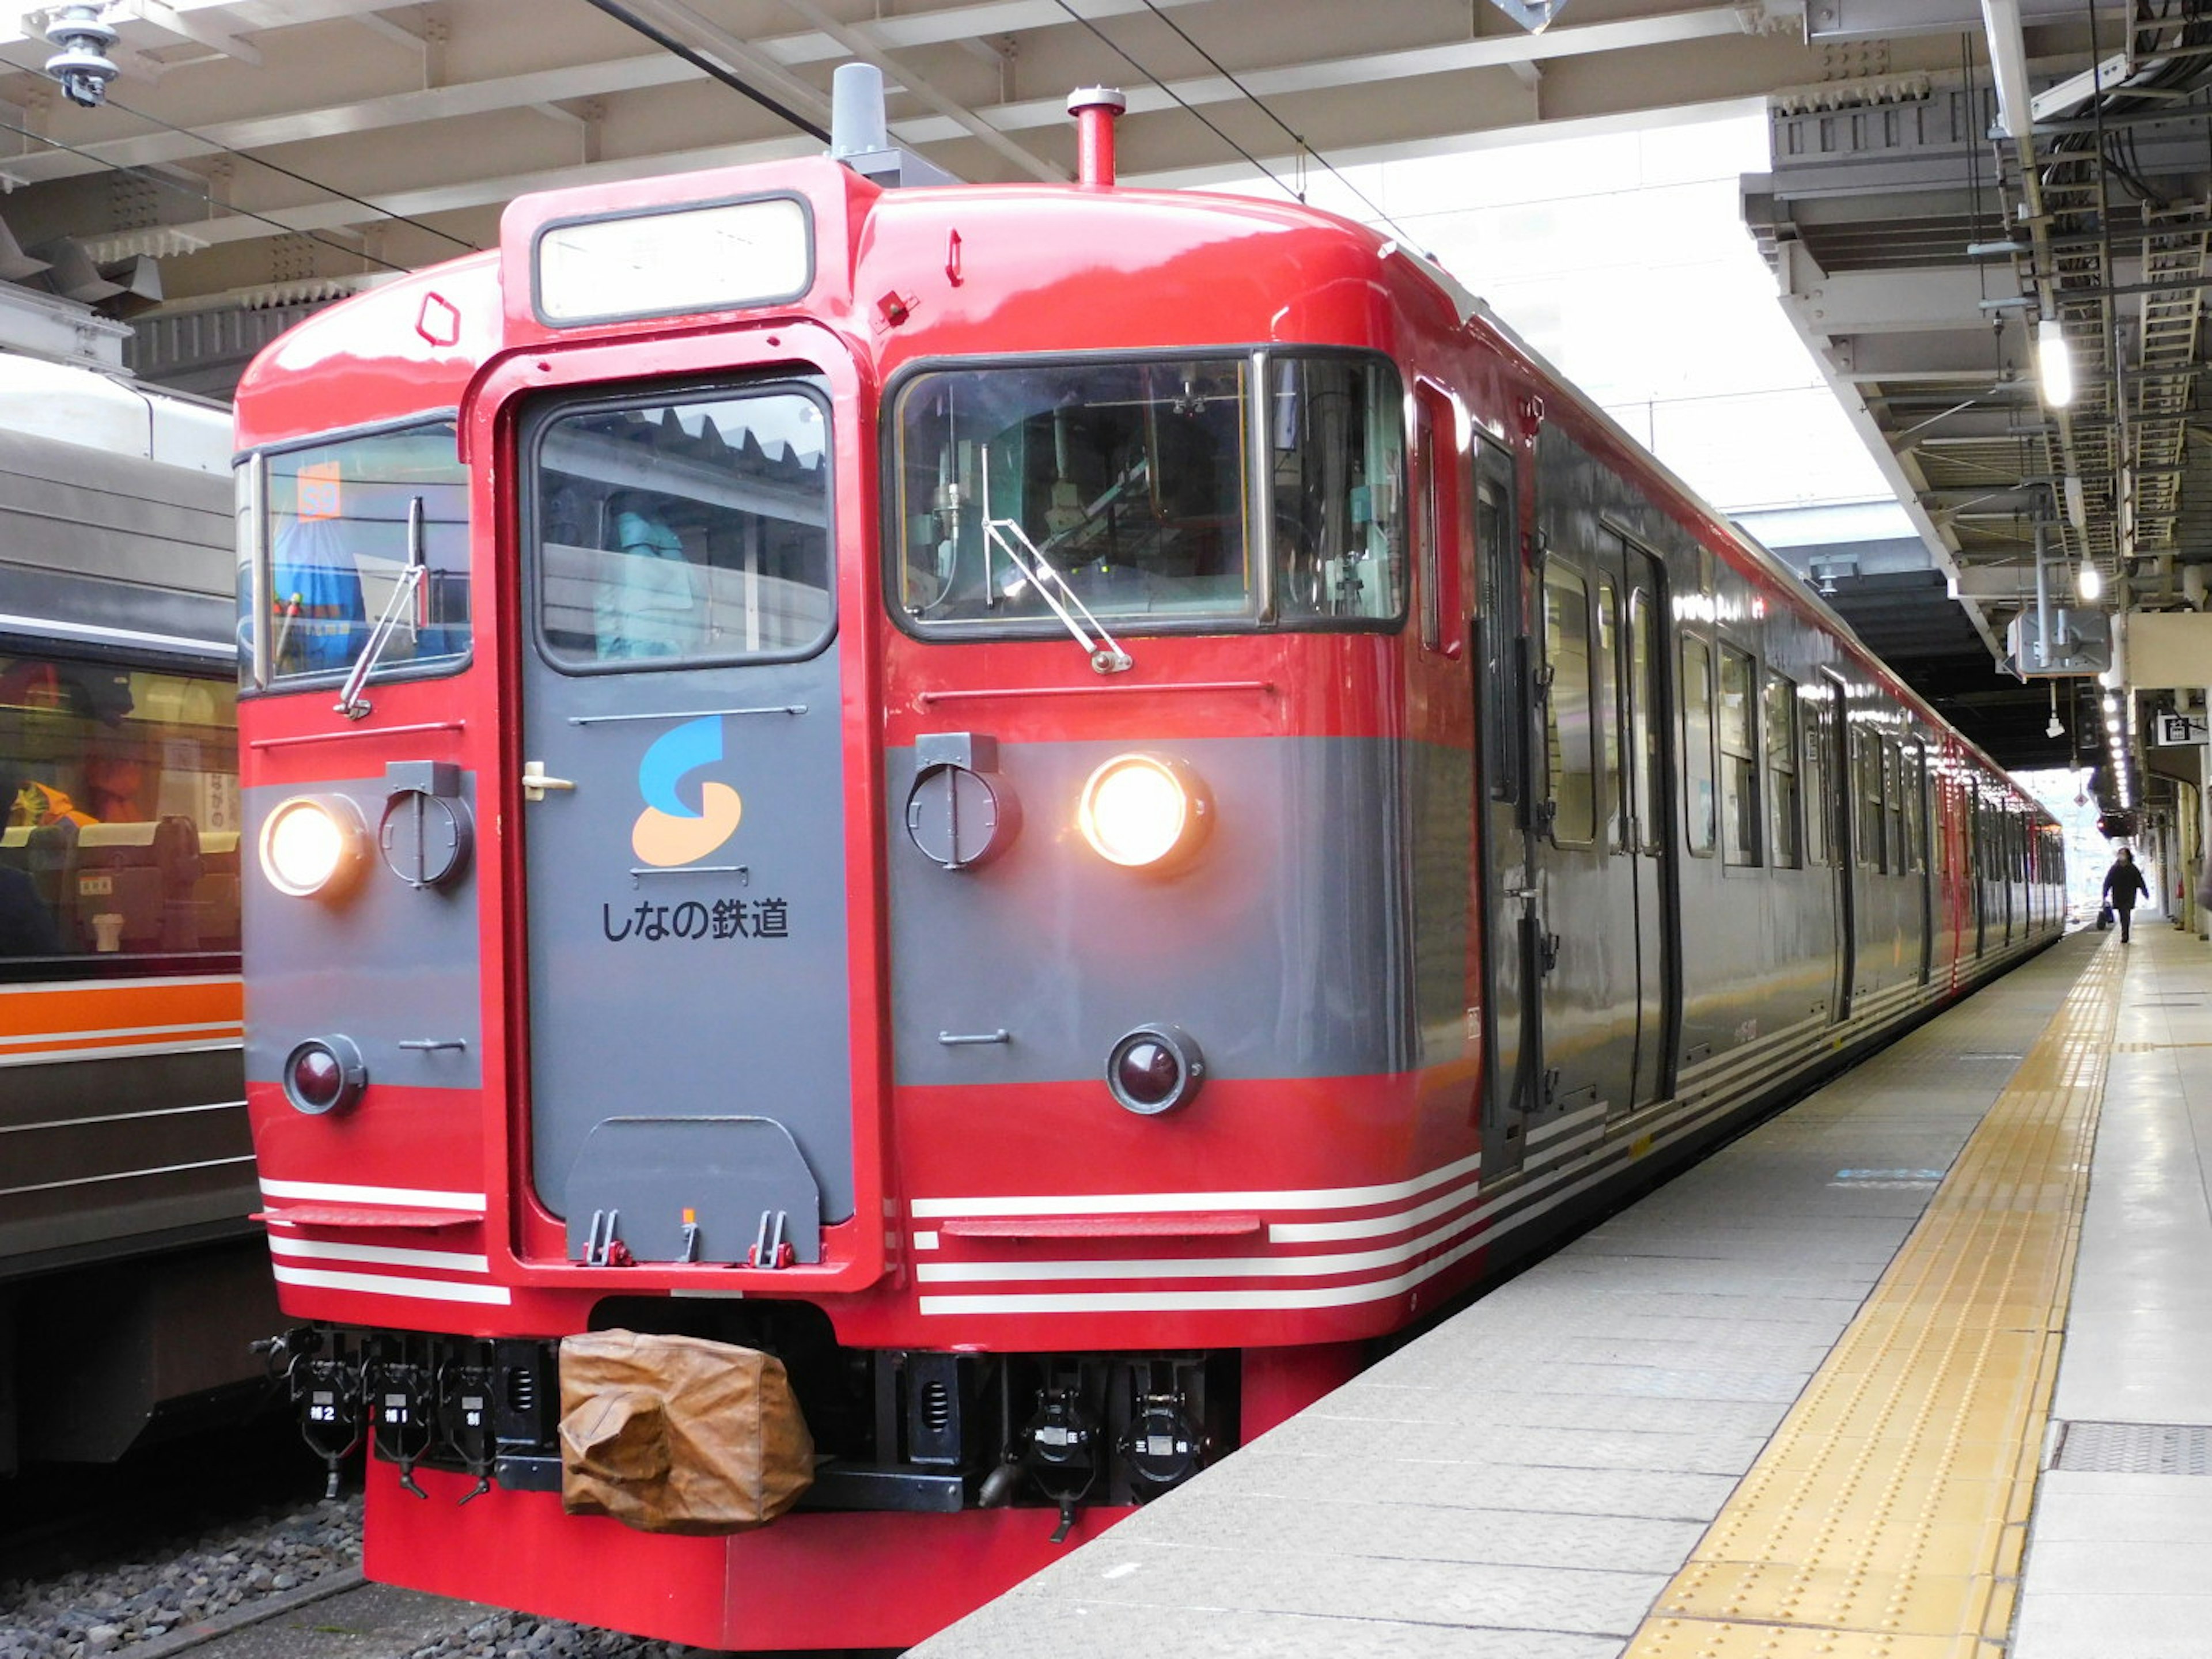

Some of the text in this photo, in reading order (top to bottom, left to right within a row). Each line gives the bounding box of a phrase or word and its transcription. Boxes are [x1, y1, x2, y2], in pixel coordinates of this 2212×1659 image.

[303, 482, 338, 516] S9
[603, 897, 789, 942] しなの鉄道
